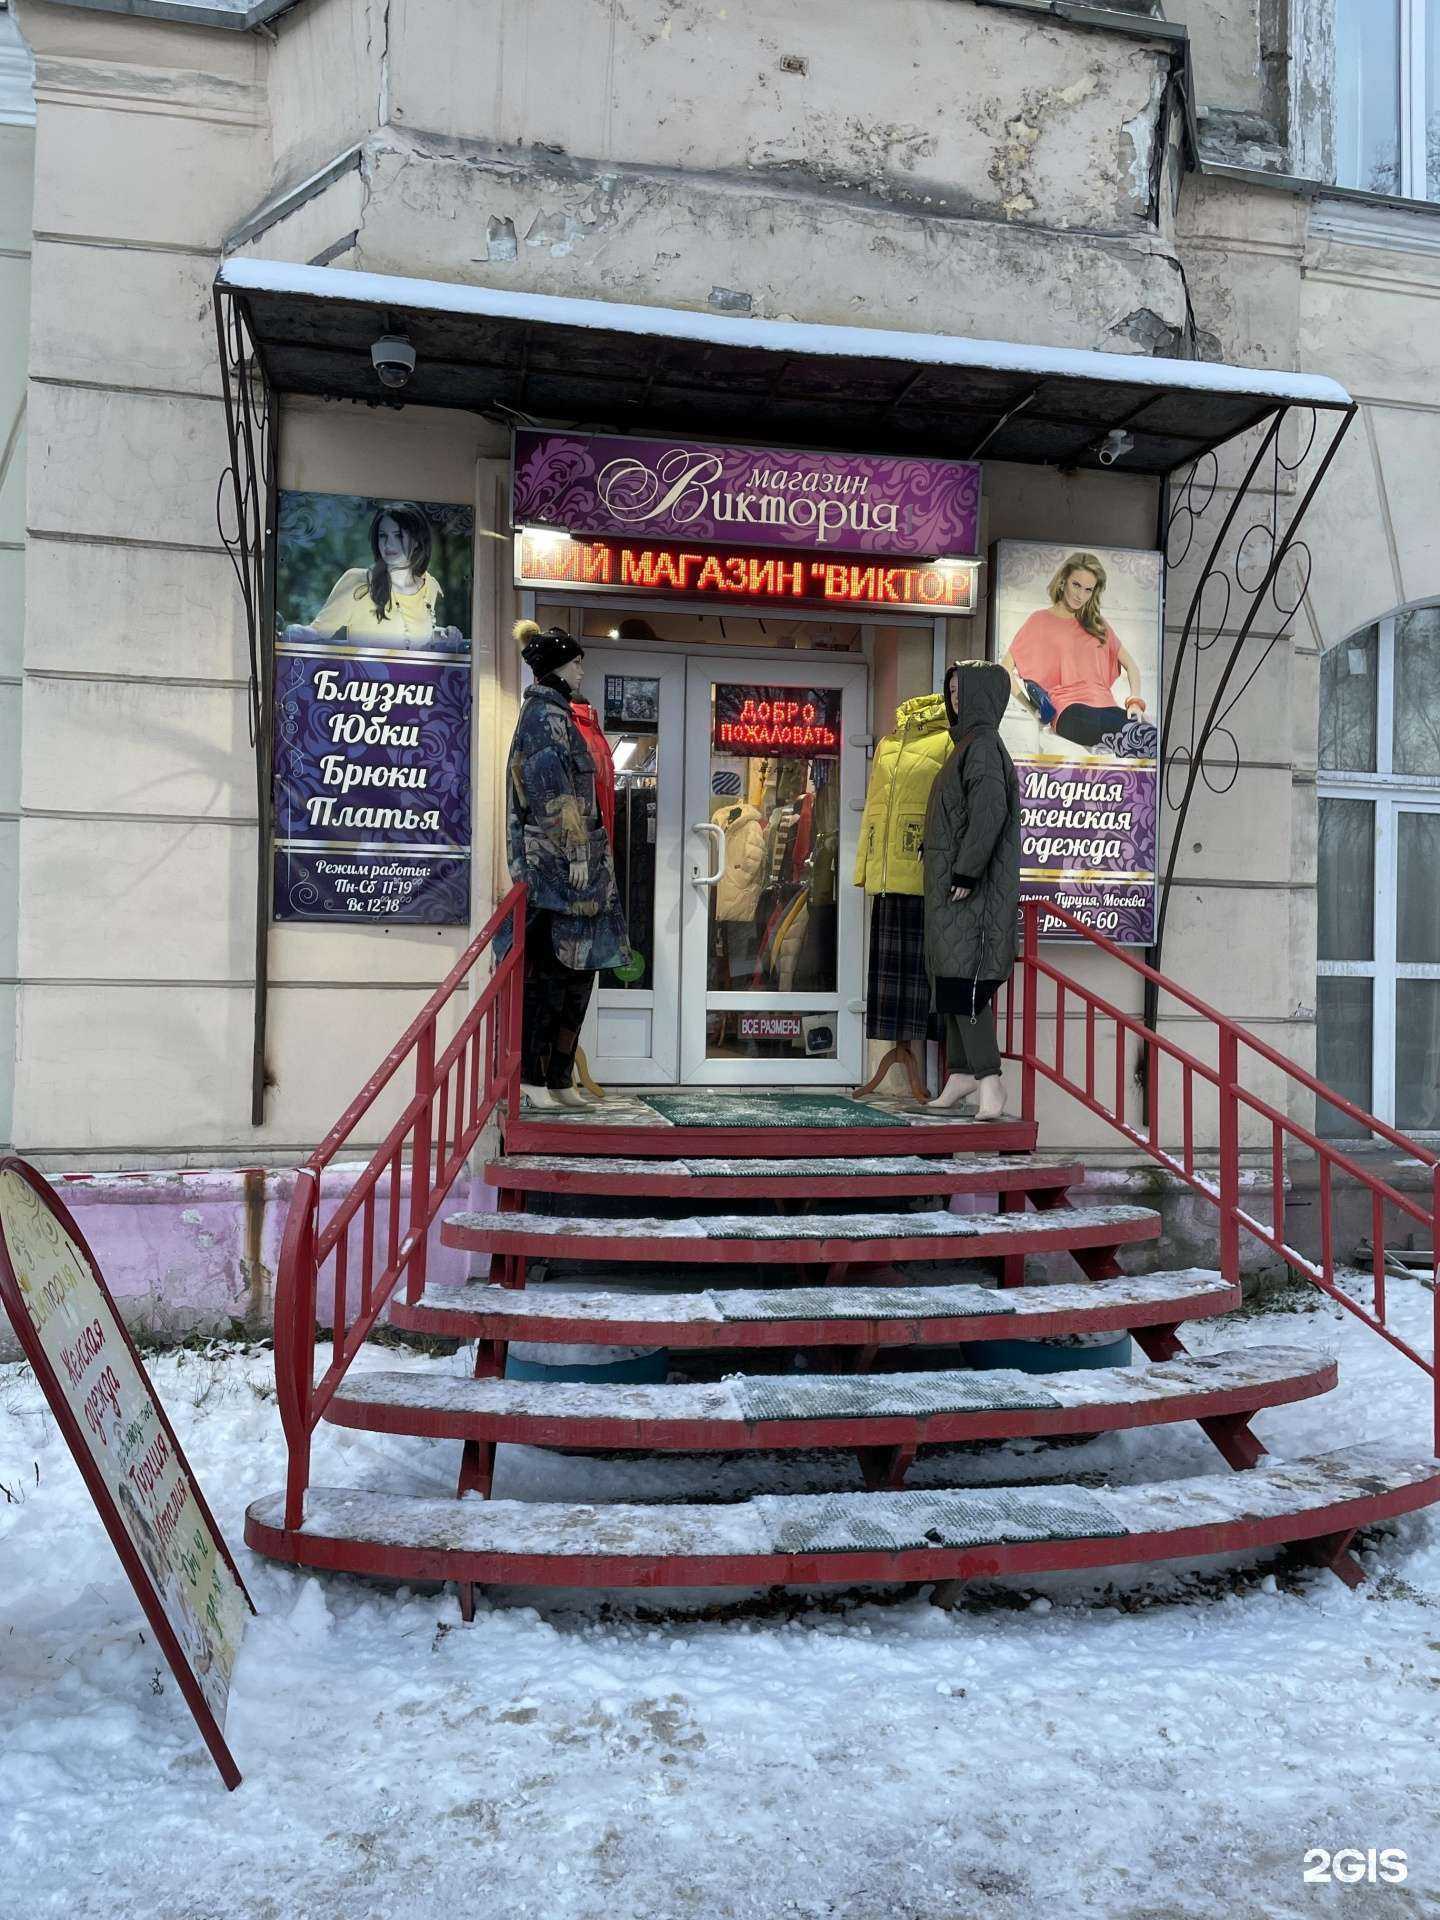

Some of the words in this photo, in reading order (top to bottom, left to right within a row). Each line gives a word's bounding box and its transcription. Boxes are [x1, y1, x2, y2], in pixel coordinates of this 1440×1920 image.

[746, 465, 869, 496] магазин
[597, 448, 900, 542] Виктория
[621, 549, 802, 596] МАГАЗИН
[313, 670, 434, 712] Блузки
[740, 699, 816, 723] ДОБРО
[328, 713, 420, 747] Юбки
[720, 722, 835, 745] ПОЖАЛОВАТЬ
[319, 754, 427, 794] Брюки
[1024, 772, 1123, 808] Модная
[306, 797, 440, 830] Платья
[1020, 808, 1132, 831] женская
[1022, 836, 1121, 864] одежда
[315, 859, 369, 875] Режим
[370, 863, 431, 879] работы:
[334, 879, 378, 893] Пн-Сб
[346, 897, 364, 912] Вс
[1054, 892, 1100, 909] Турция,
[1103, 893, 1146, 908] Москва
[741, 1019, 759, 1034] ВСЕ
[760, 1019, 800, 1035] РАЗМЕРЫ
